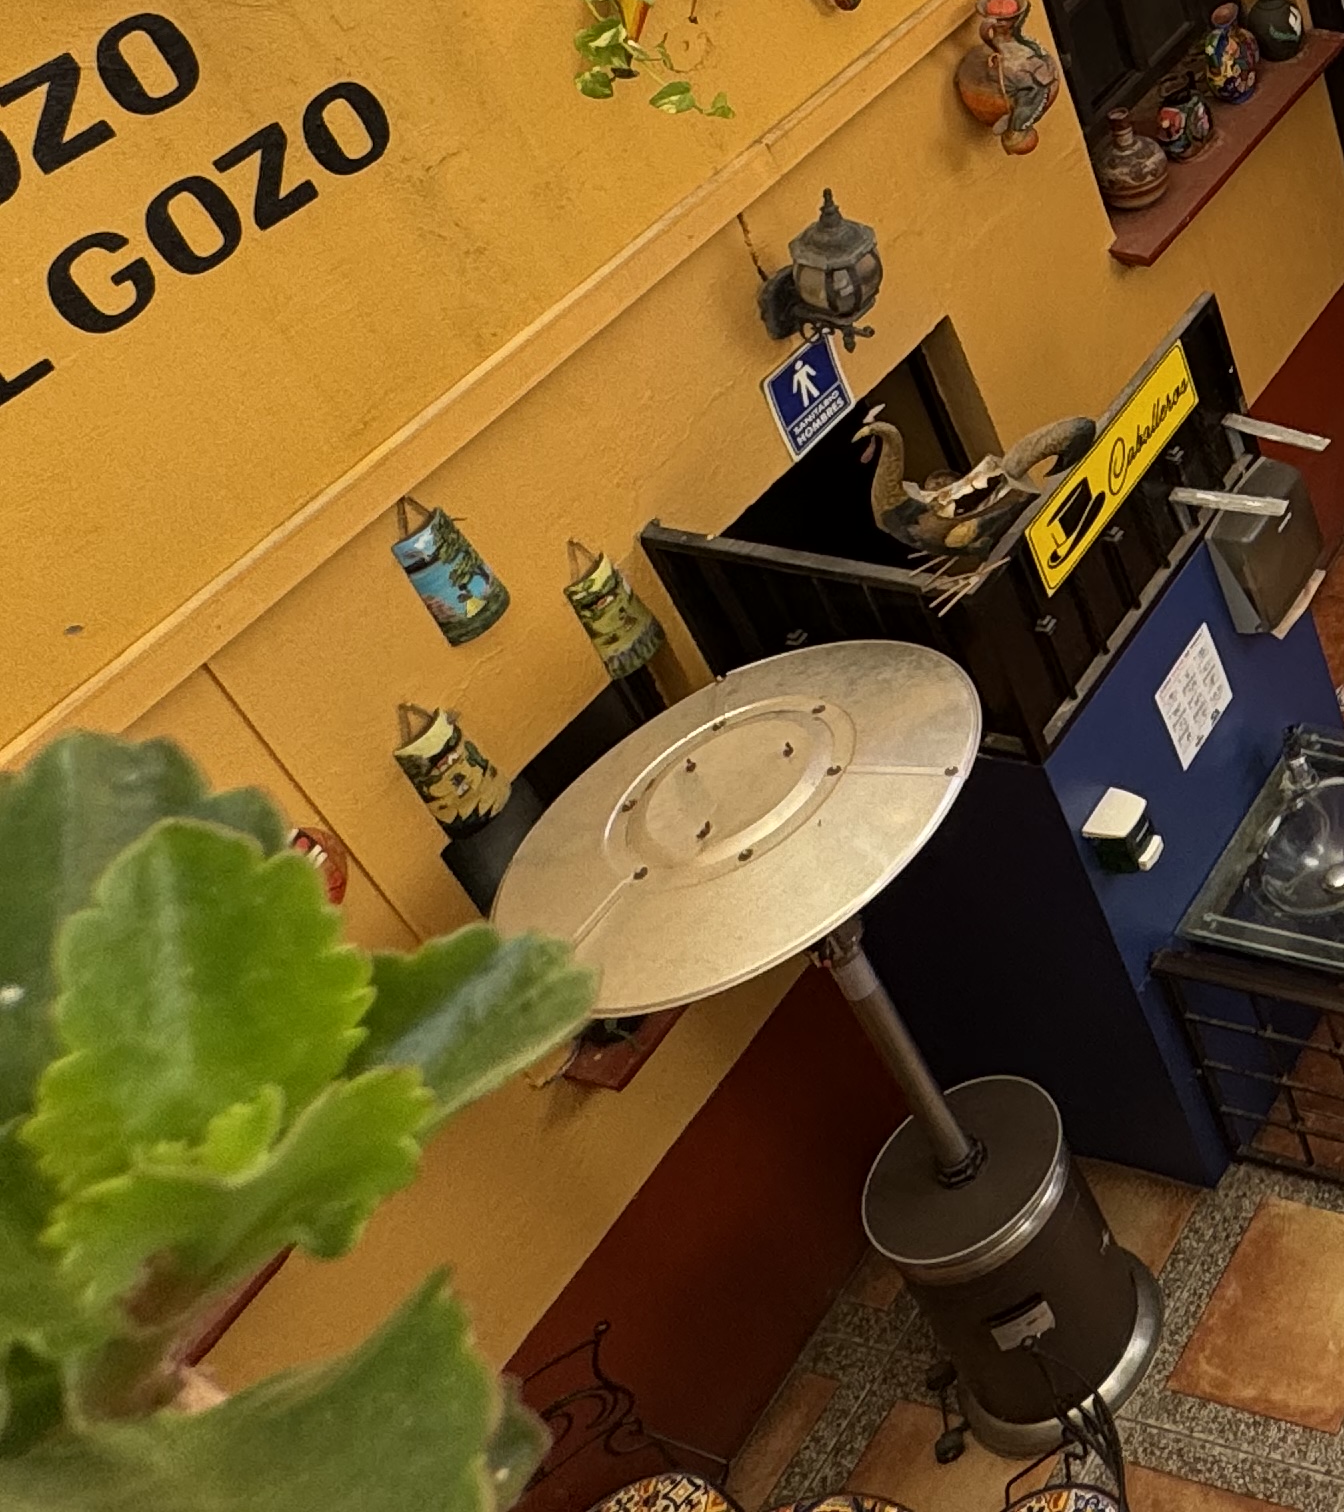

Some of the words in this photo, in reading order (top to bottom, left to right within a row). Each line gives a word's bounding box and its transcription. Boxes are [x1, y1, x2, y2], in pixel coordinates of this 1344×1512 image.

[47, 82, 391, 334] GOZO
[793, 390, 840, 435] SANITARIO
[796, 397, 845, 446] HOMBRES
[1109, 378, 1189, 496] Caballeros
